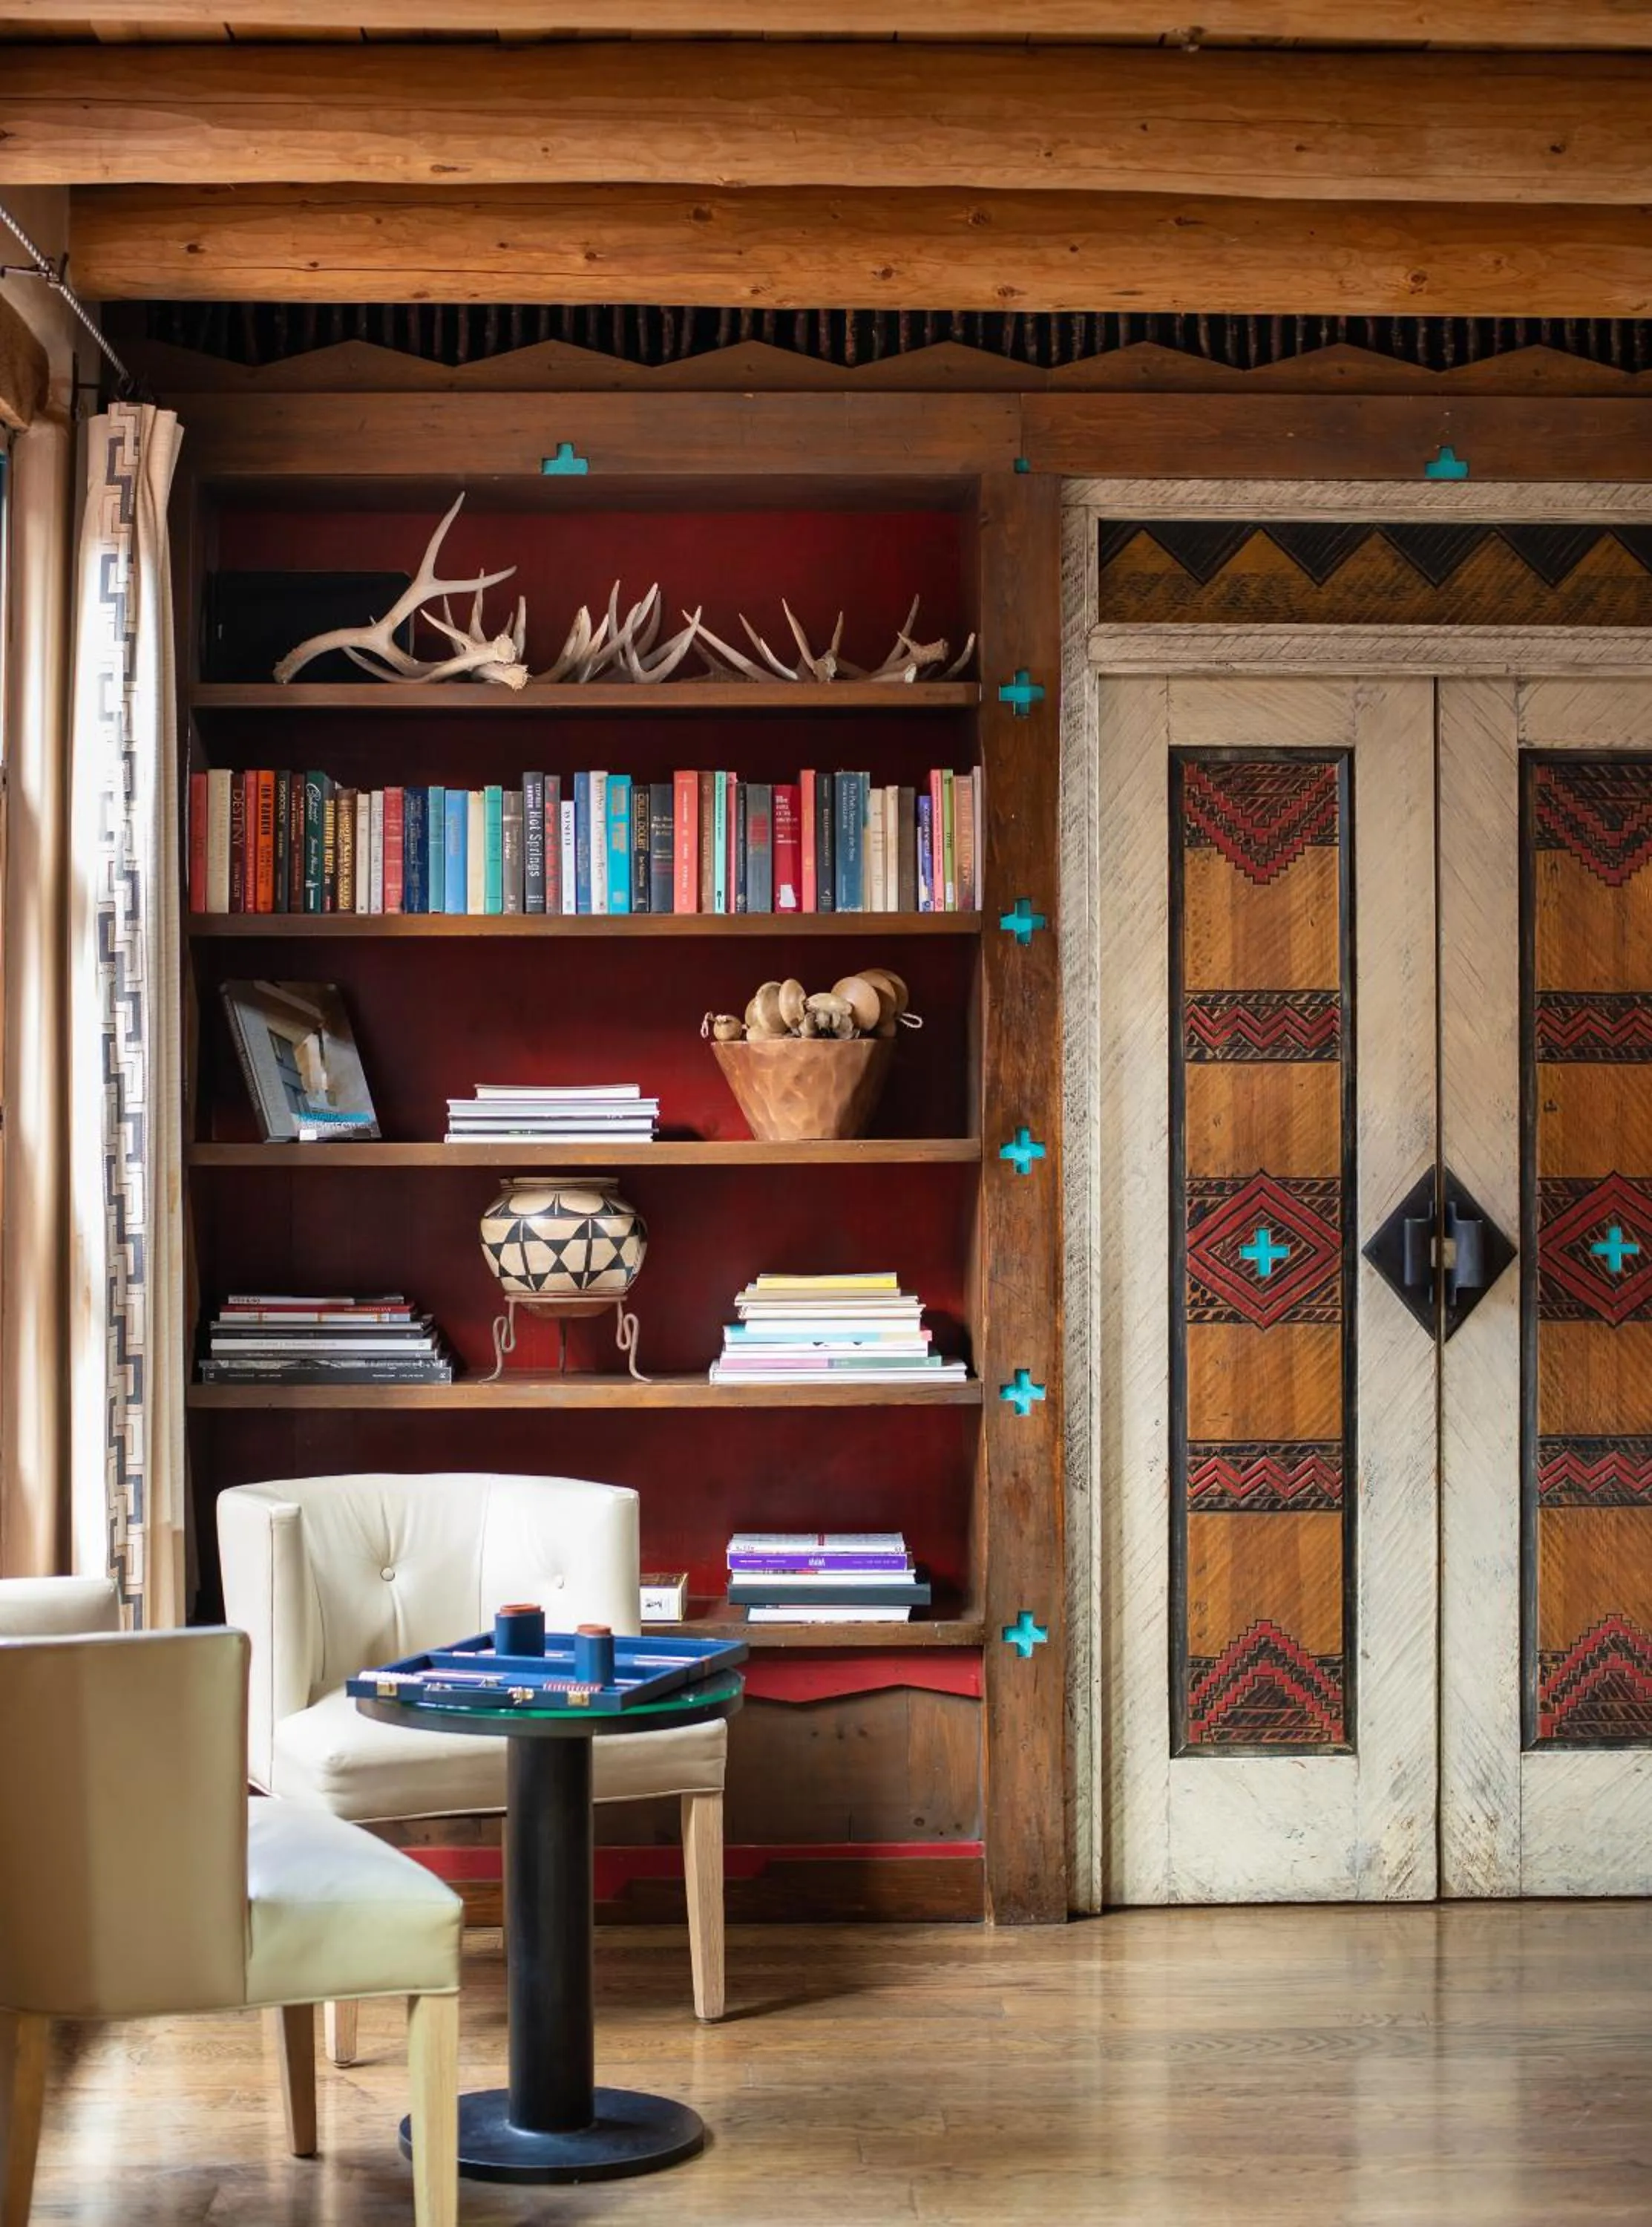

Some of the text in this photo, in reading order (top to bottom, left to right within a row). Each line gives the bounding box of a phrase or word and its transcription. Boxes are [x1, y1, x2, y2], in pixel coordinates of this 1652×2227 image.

[260, 784, 272, 799] IAN
[232, 788, 244, 848] DESTINY
[260, 803, 272, 836] RANKIN
[526, 811, 542, 877] Hot Springs
